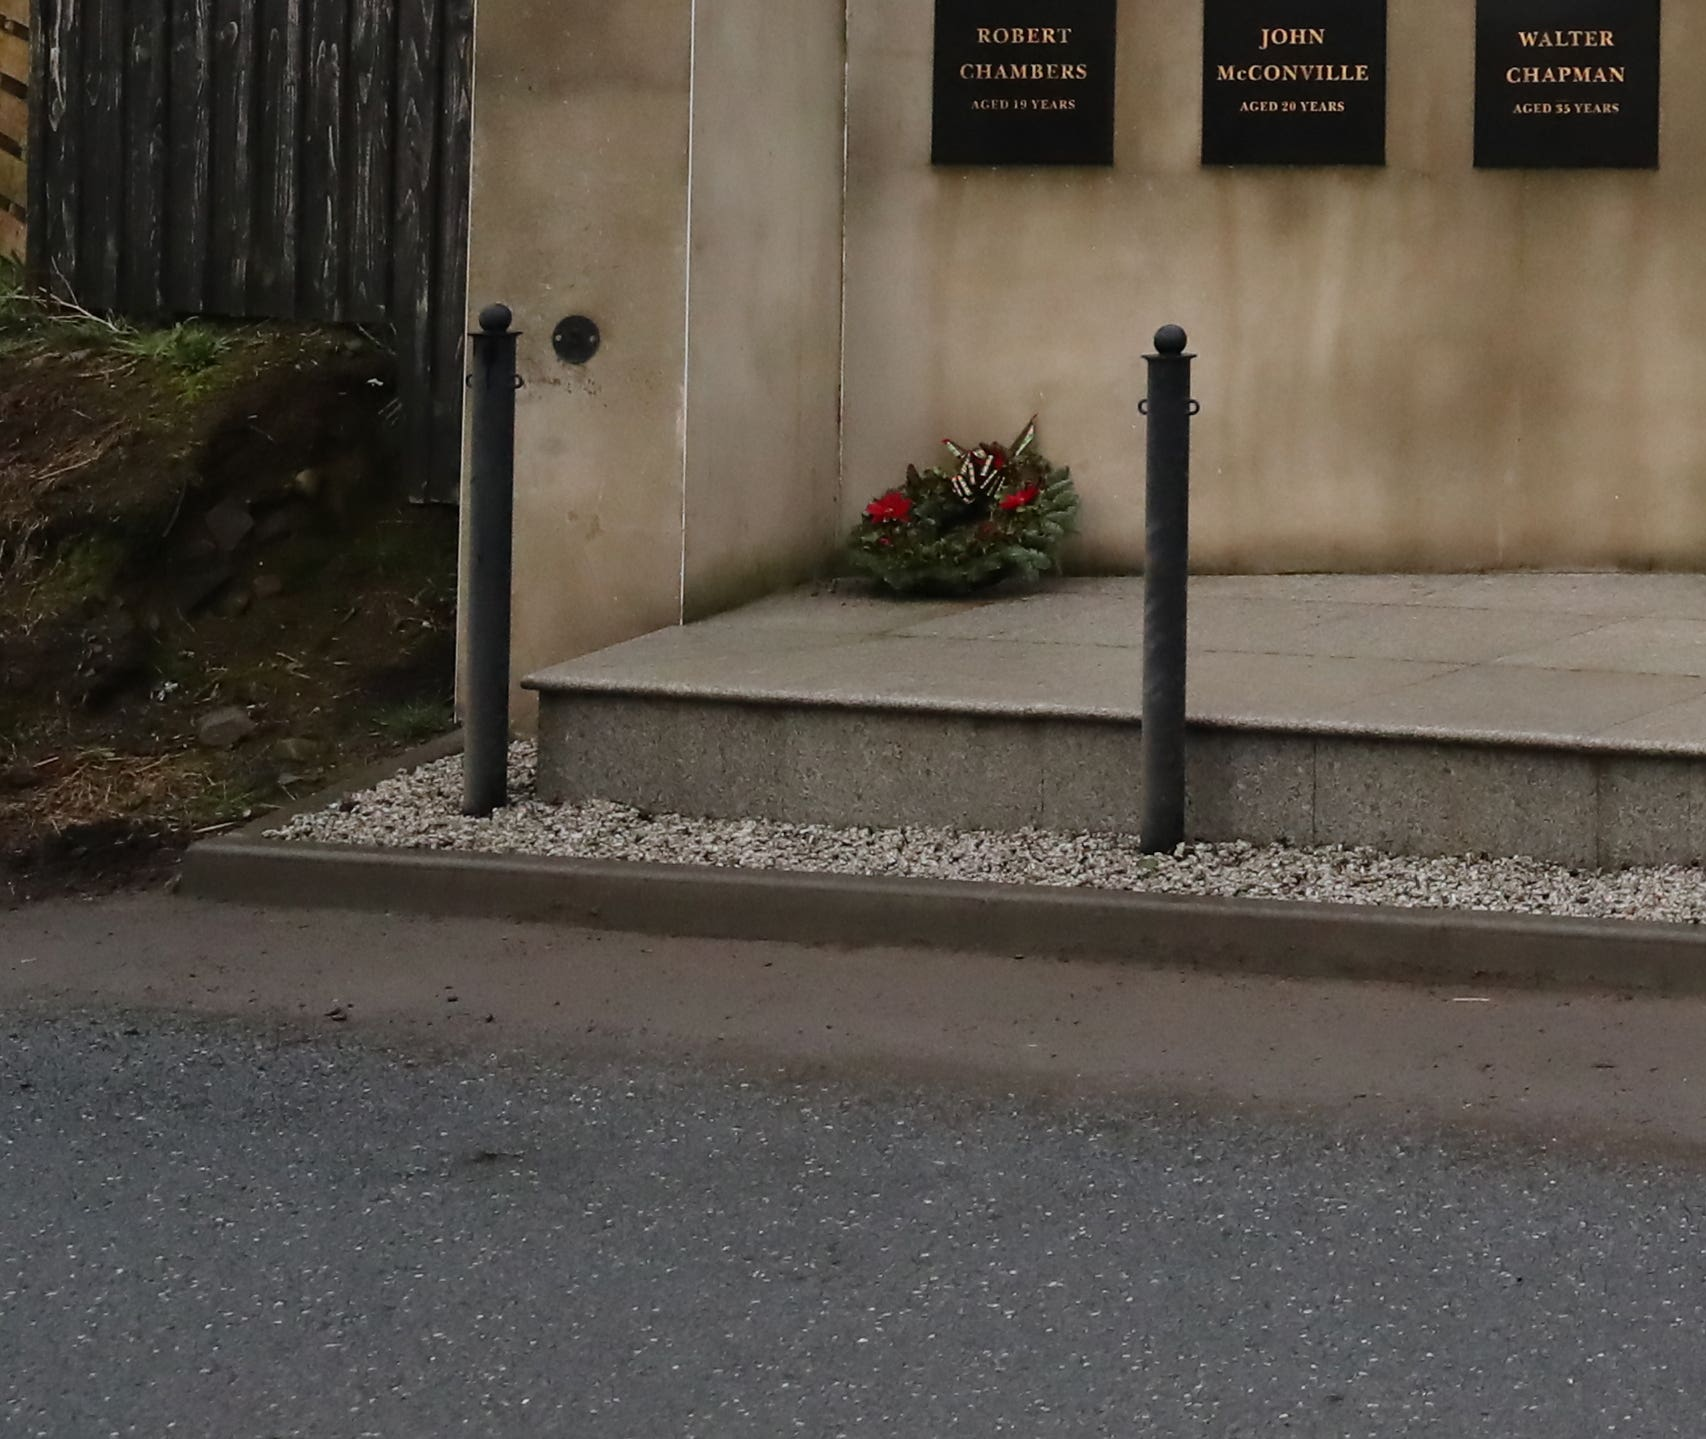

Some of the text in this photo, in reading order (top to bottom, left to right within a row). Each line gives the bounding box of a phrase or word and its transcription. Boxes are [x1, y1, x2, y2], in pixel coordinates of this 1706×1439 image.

[977, 28, 1071, 43] ROBERT
[1259, 28, 1325, 49] JOHN
[1518, 31, 1614, 47] WALTER
[960, 64, 1087, 79] CHAMBERS
[1217, 65, 1368, 81] McCONVILLE
[1506, 67, 1624, 83] CHAPMAN
[972, 100, 1075, 109] AGED 19 YEARS
[1240, 101, 1344, 111] AGED 20 YEARS
[1513, 103, 1619, 114] AGED 35 YEARS
